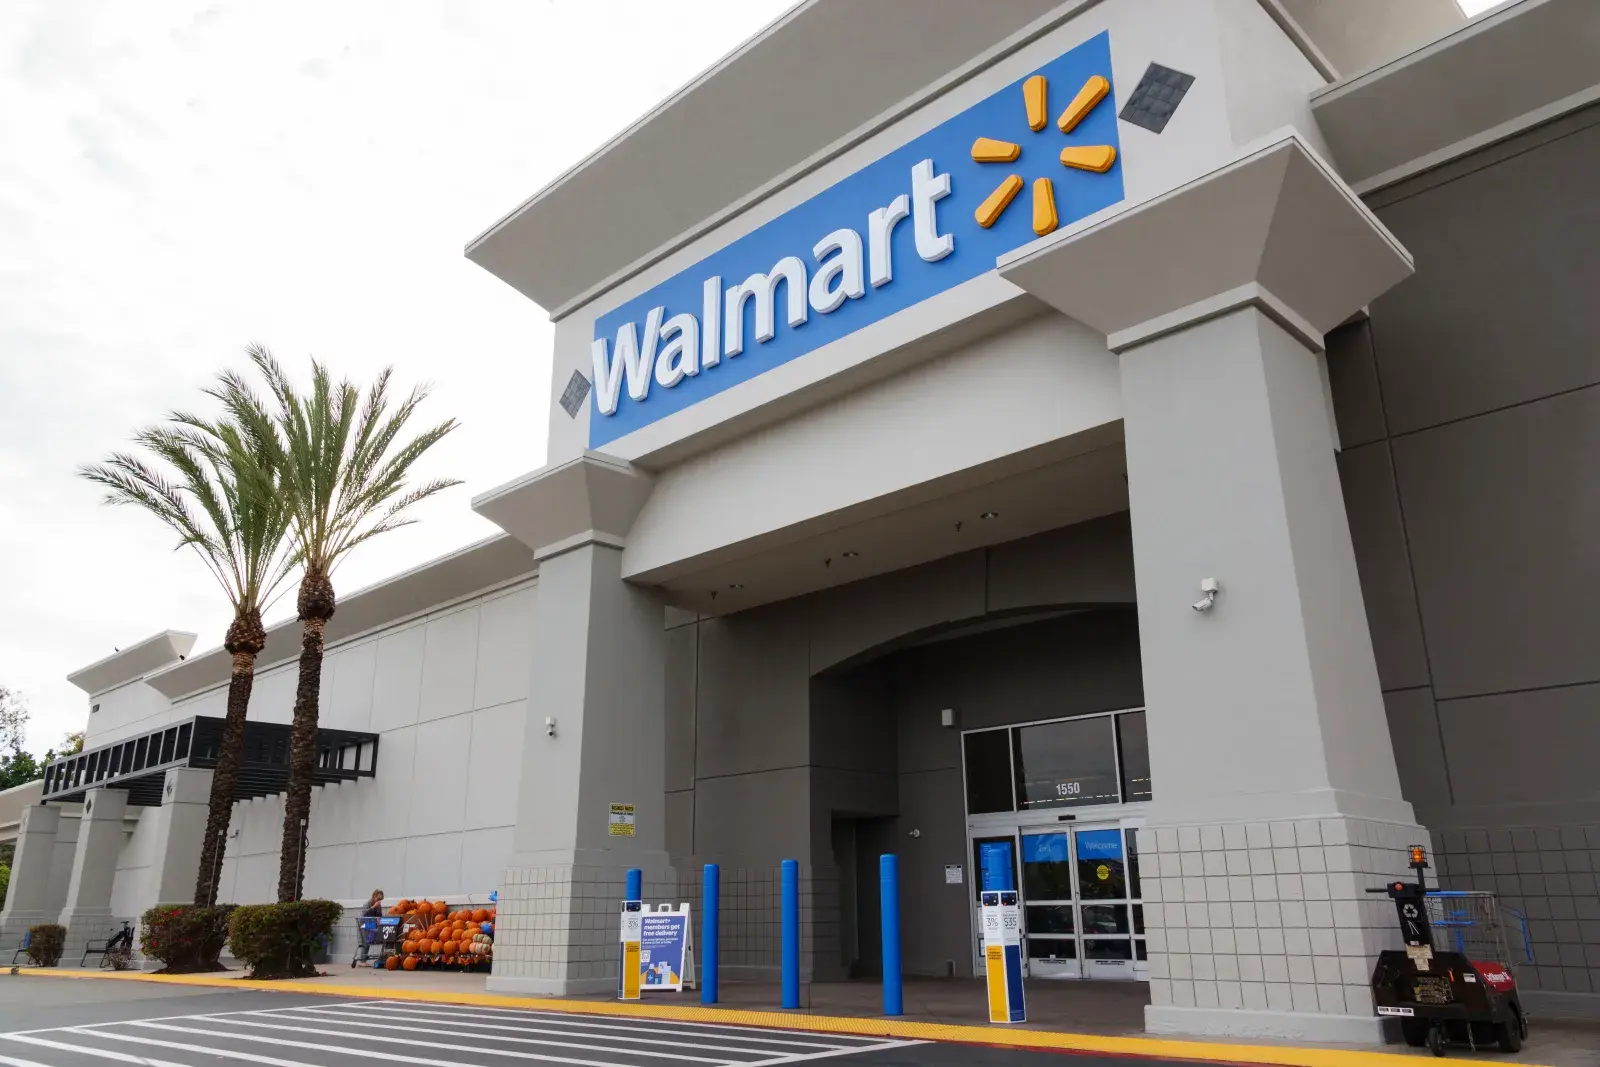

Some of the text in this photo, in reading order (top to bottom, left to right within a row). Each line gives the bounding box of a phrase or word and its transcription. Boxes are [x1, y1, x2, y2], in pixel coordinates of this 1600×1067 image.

[591, 158, 955, 416] Walmart
[1056, 782, 1080, 795] 1550
[628, 920, 639, 928] 3%
[986, 917, 999, 927] 3%
[1003, 917, 1017, 927] $35
